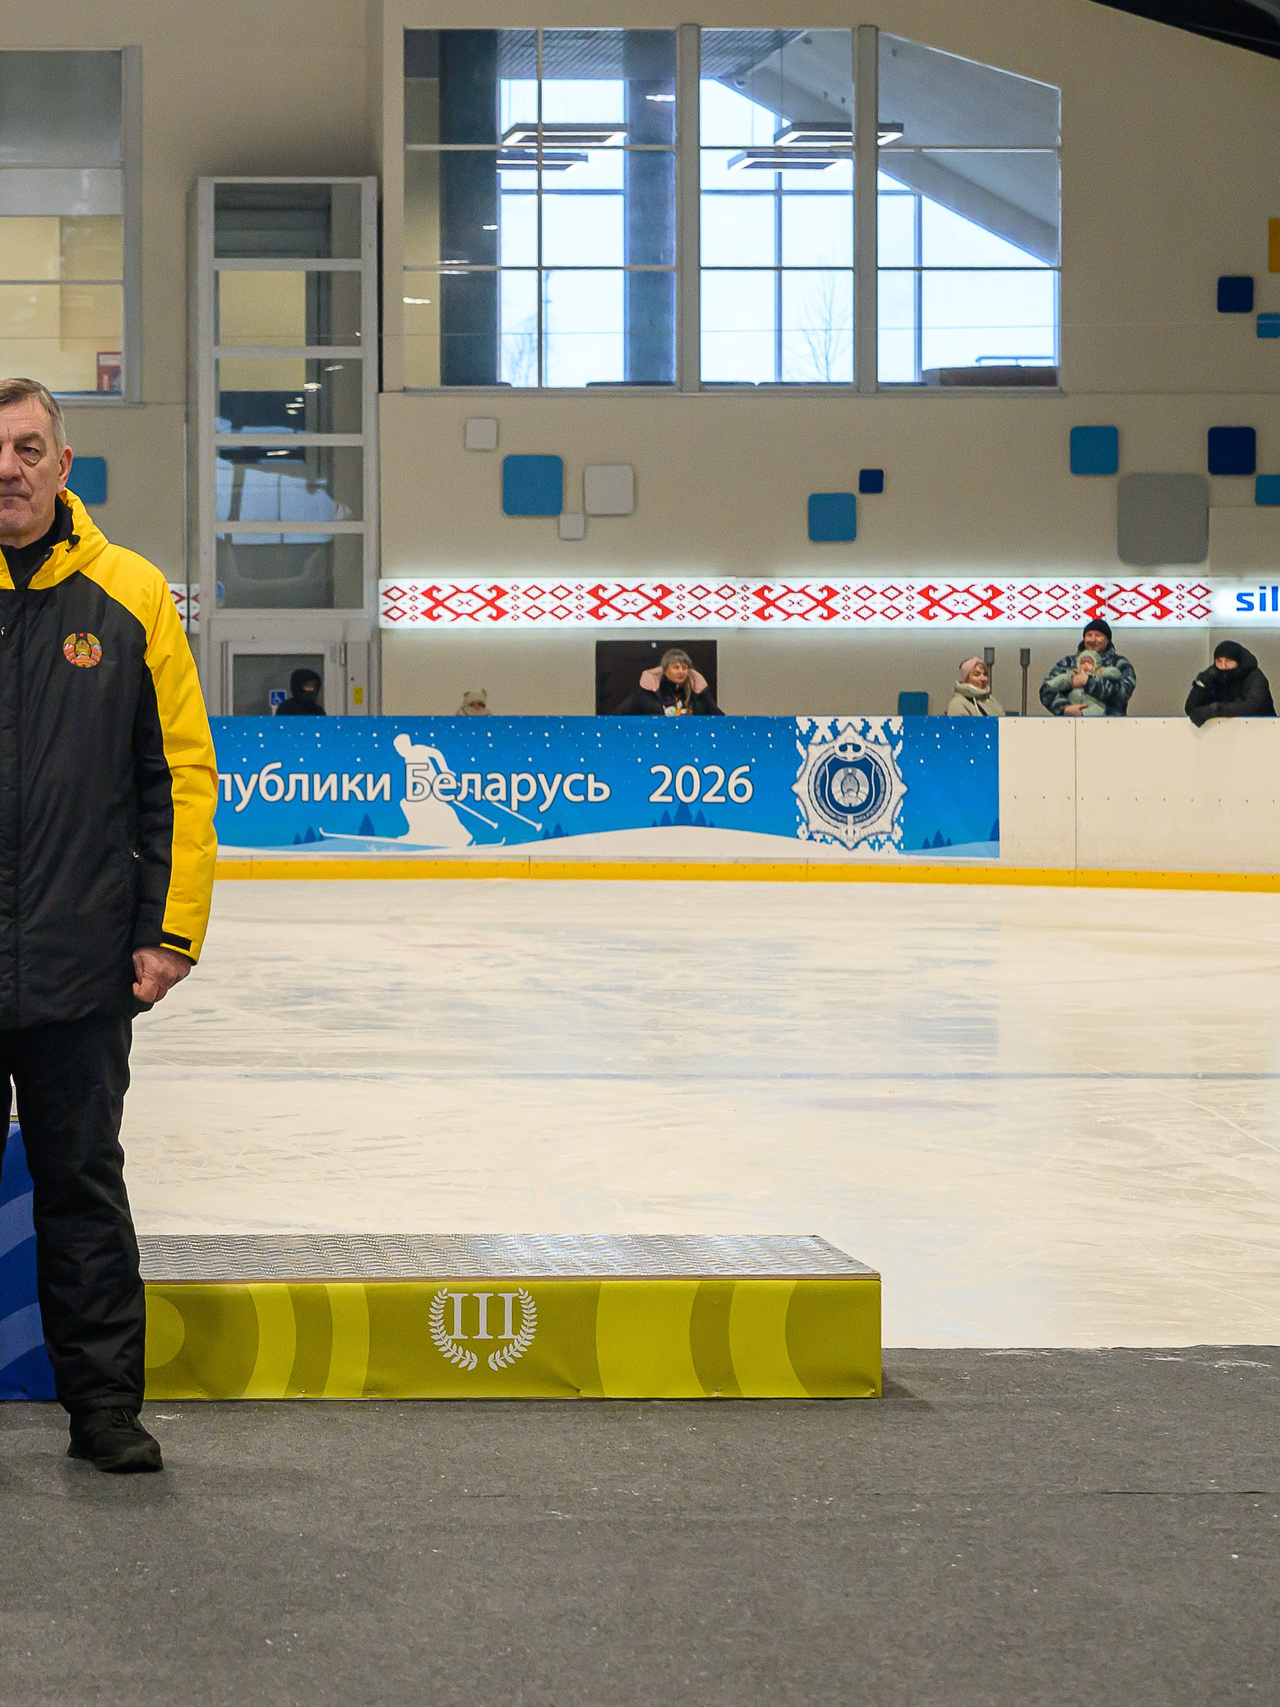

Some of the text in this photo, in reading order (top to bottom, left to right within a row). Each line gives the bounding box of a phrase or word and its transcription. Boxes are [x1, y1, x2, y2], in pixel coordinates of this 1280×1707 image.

[1236, 585, 1279, 612] sil
[405, 763, 611, 813] Беларусь
[648, 764, 754, 804] 2026
[447, 1292, 520, 1340] III
